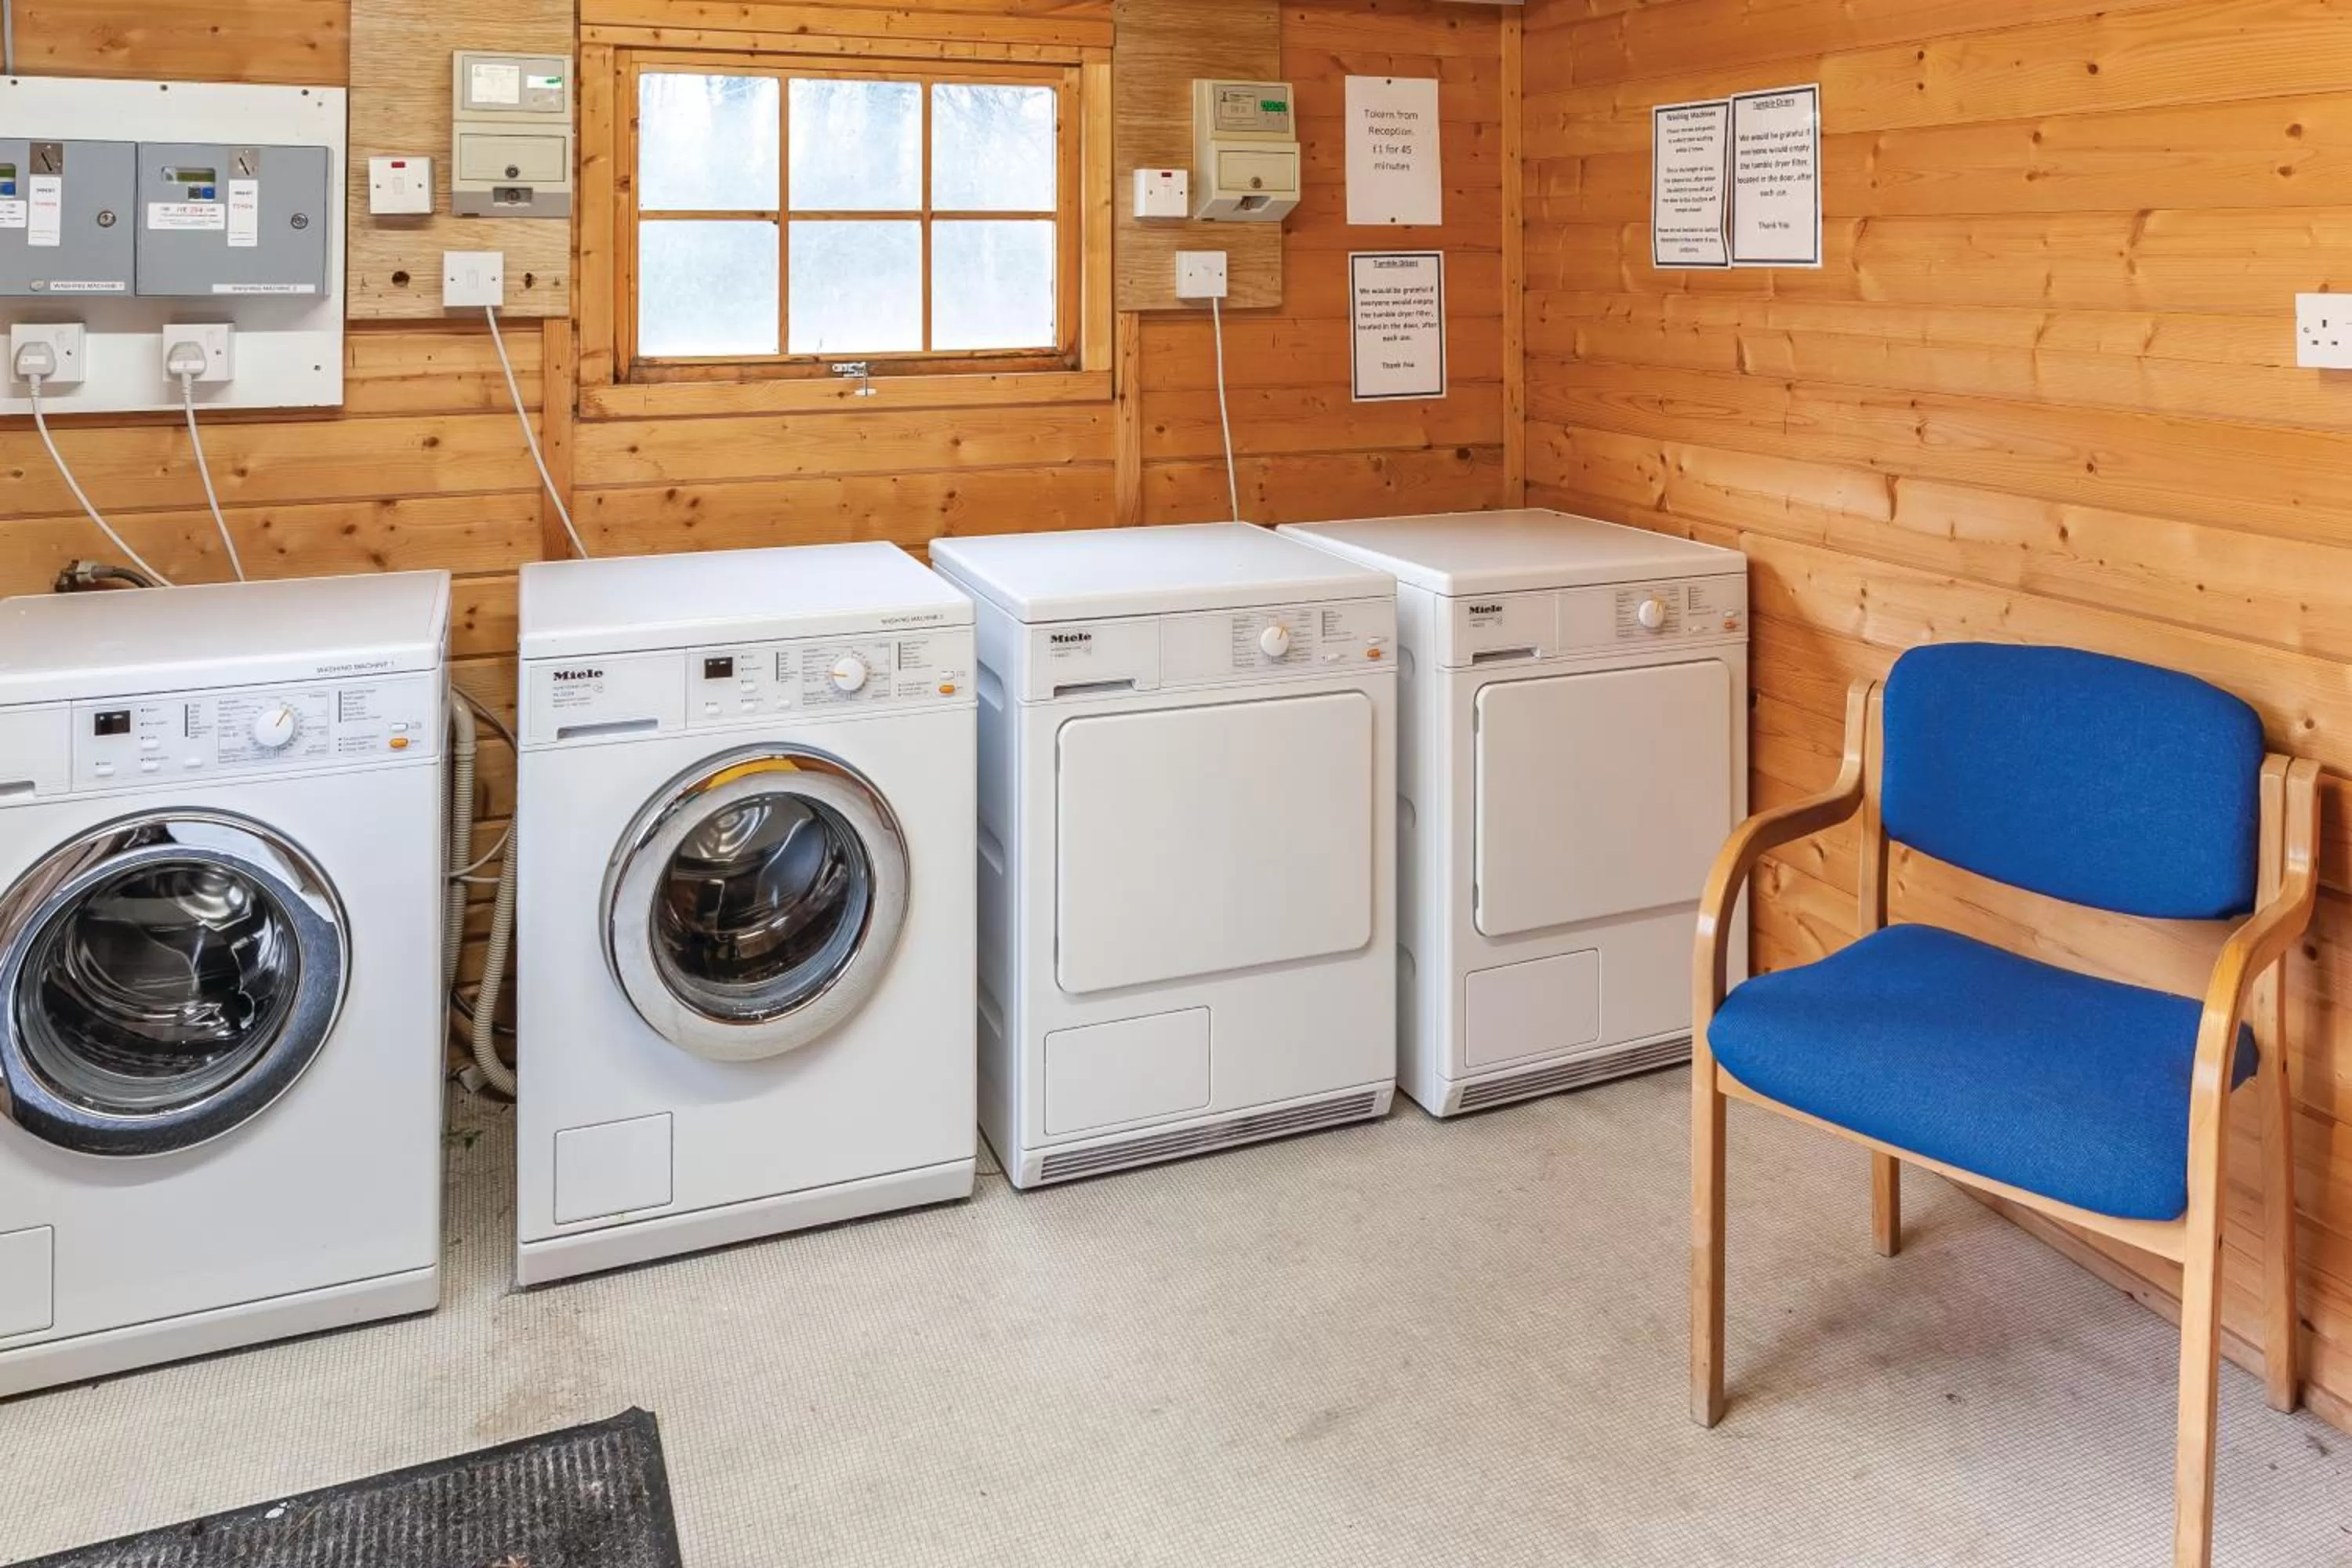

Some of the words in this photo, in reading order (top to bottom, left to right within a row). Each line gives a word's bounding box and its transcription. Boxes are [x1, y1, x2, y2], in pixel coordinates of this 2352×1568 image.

[1751, 131, 1769, 140] would
[1385, 144, 1399, 154] for
[1401, 145, 1412, 154] 45
[1769, 144, 1788, 154] would
[1374, 162, 1410, 171] minutes
[1468, 604, 1504, 615] Miele
[1050, 633, 1092, 644] Miele
[552, 669, 604, 681] Miele
